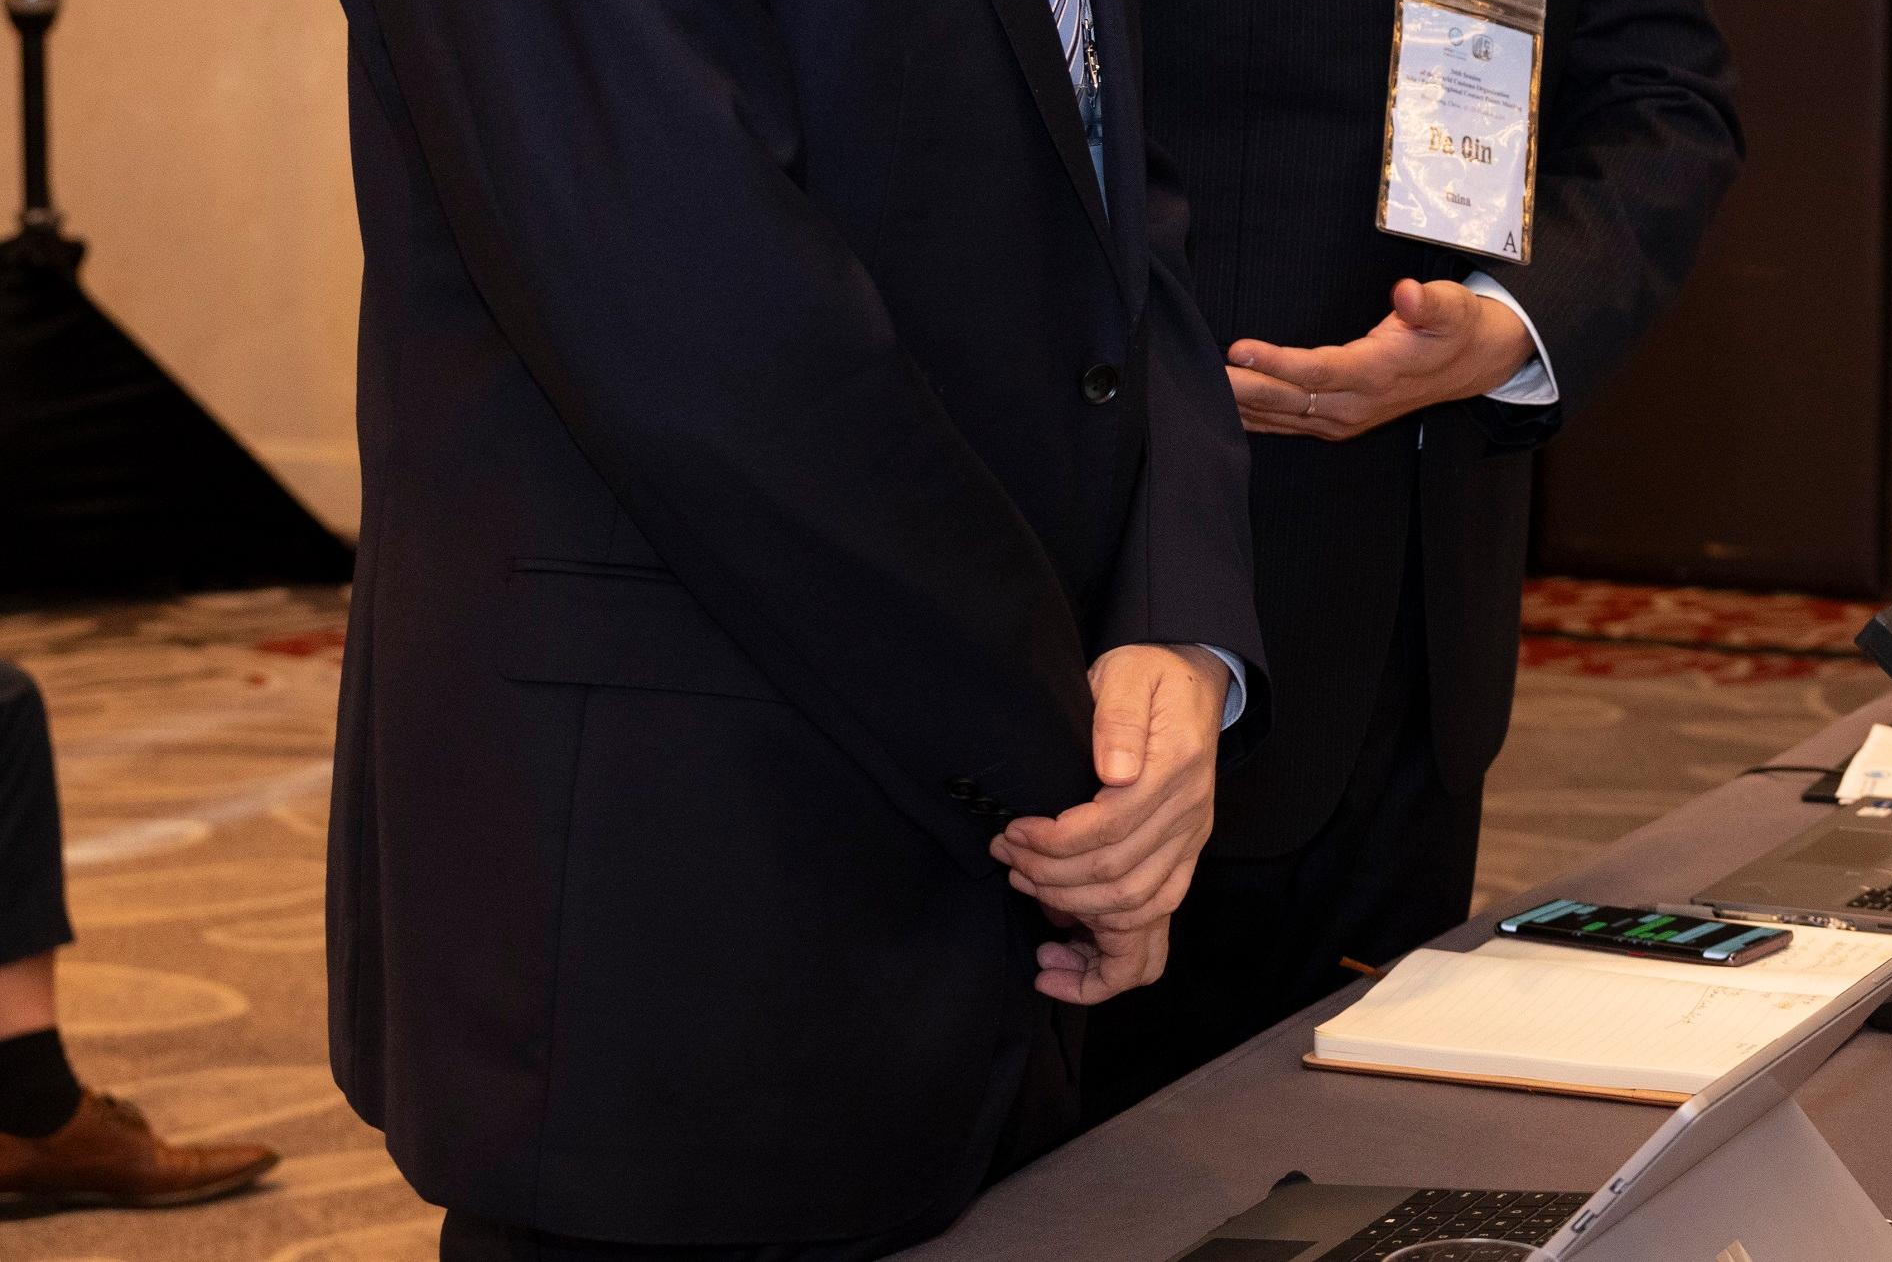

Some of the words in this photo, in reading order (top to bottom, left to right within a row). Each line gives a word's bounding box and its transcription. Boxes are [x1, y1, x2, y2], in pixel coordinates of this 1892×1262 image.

[1462, 135, 1492, 165] Qin
[1446, 191, 1471, 207] China
[1503, 230, 1517, 254] A
